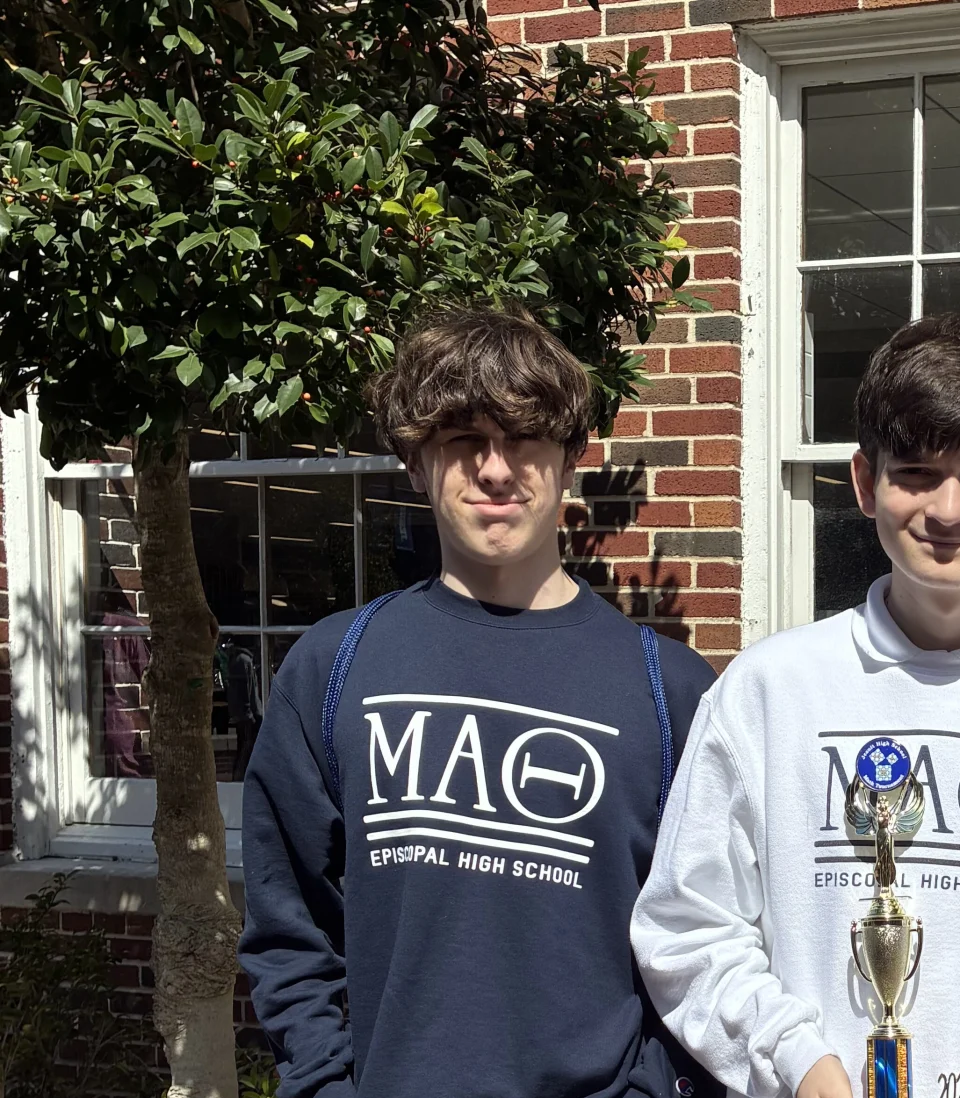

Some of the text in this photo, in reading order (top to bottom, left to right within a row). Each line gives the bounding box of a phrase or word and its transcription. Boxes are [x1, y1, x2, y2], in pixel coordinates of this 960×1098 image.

[891, 742, 907, 760] School
[369, 845, 583, 889] EPISCOPAL HIGH SCHOOL
[814, 872, 911, 888] EPISCOL
